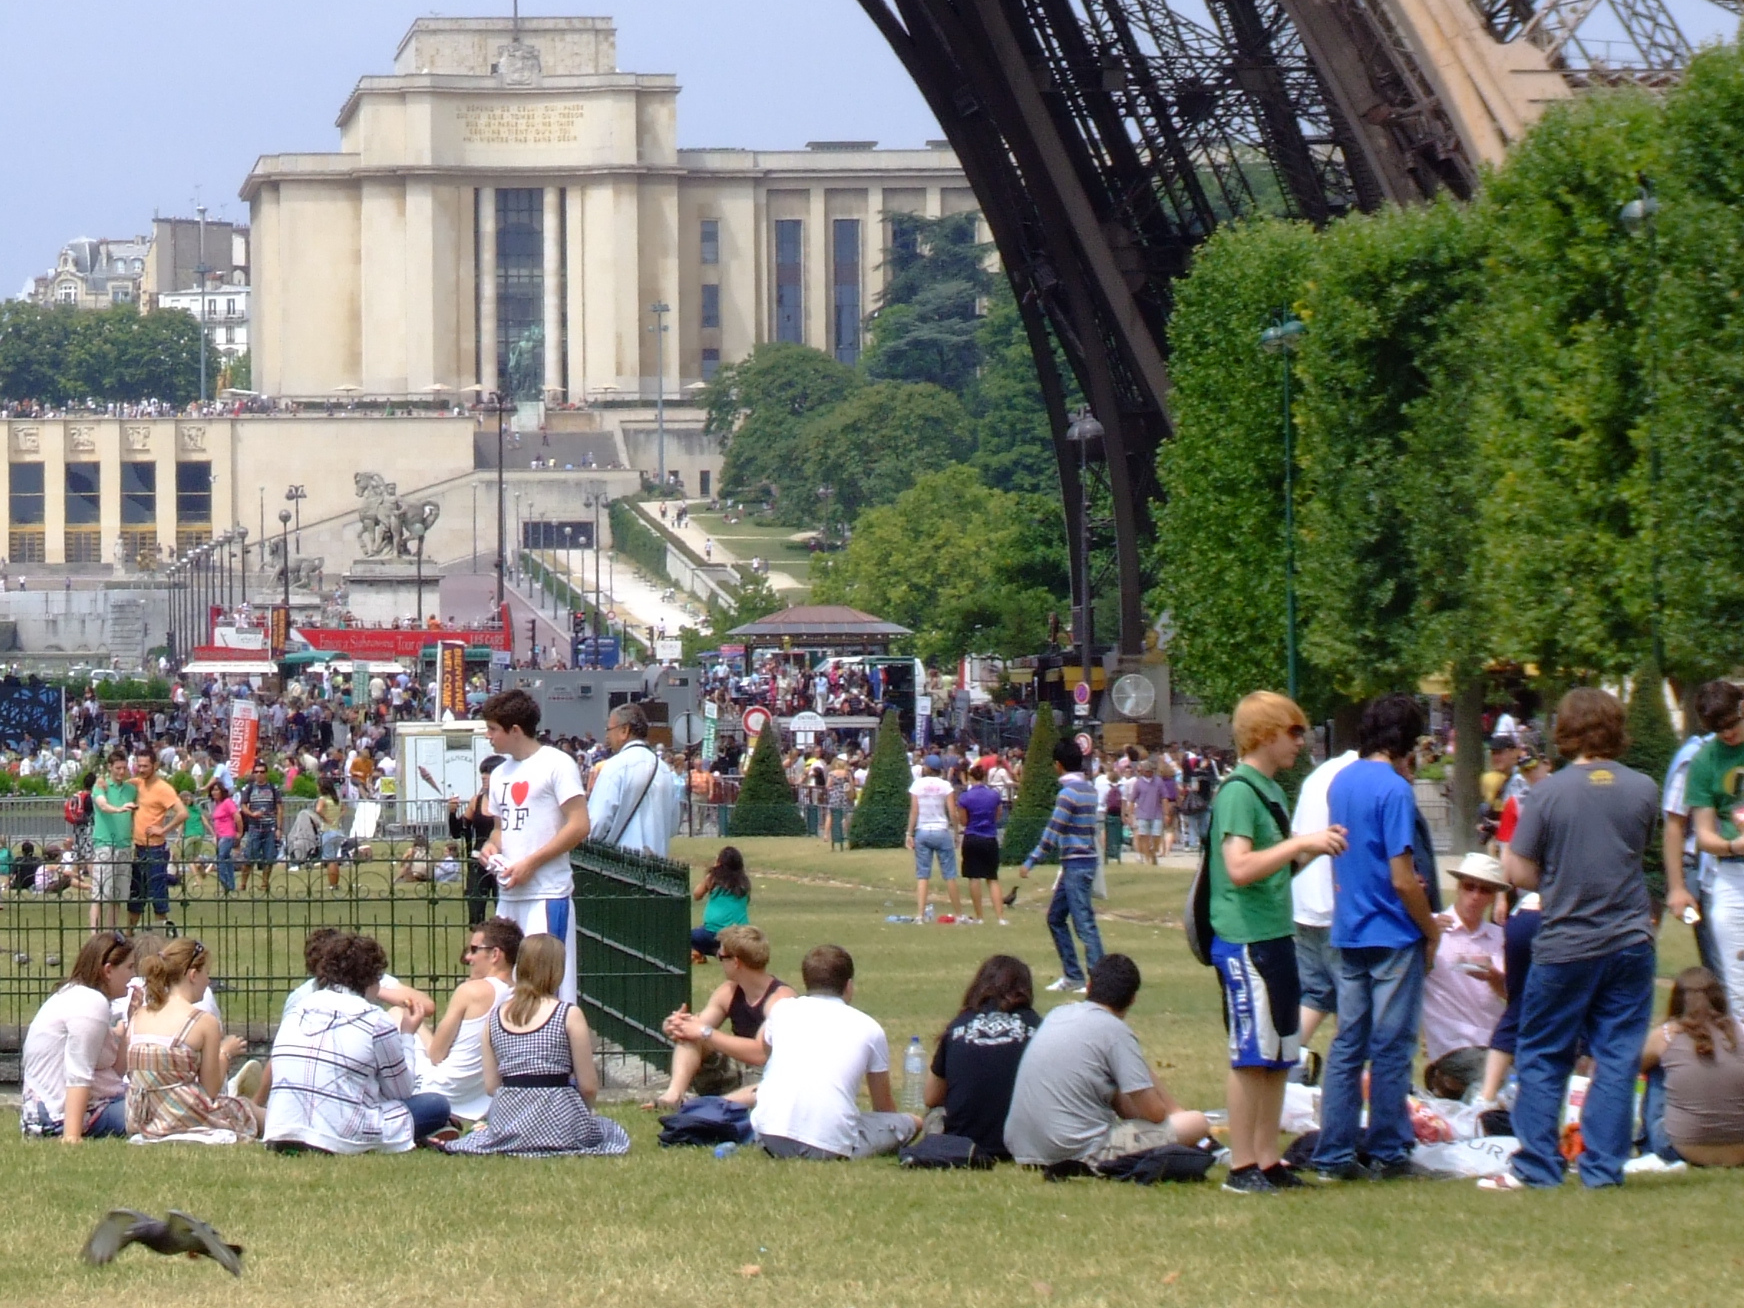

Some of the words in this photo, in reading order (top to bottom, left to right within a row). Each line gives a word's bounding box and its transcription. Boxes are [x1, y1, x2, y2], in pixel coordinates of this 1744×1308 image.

[396, 635, 415, 651] Tour
[442, 649, 453, 708] WELCOME
[453, 647, 465, 713] BIENVENUE
[229, 717, 245, 779] VISITEURS
[499, 782, 510, 806] I
[501, 807, 529, 831] SF
